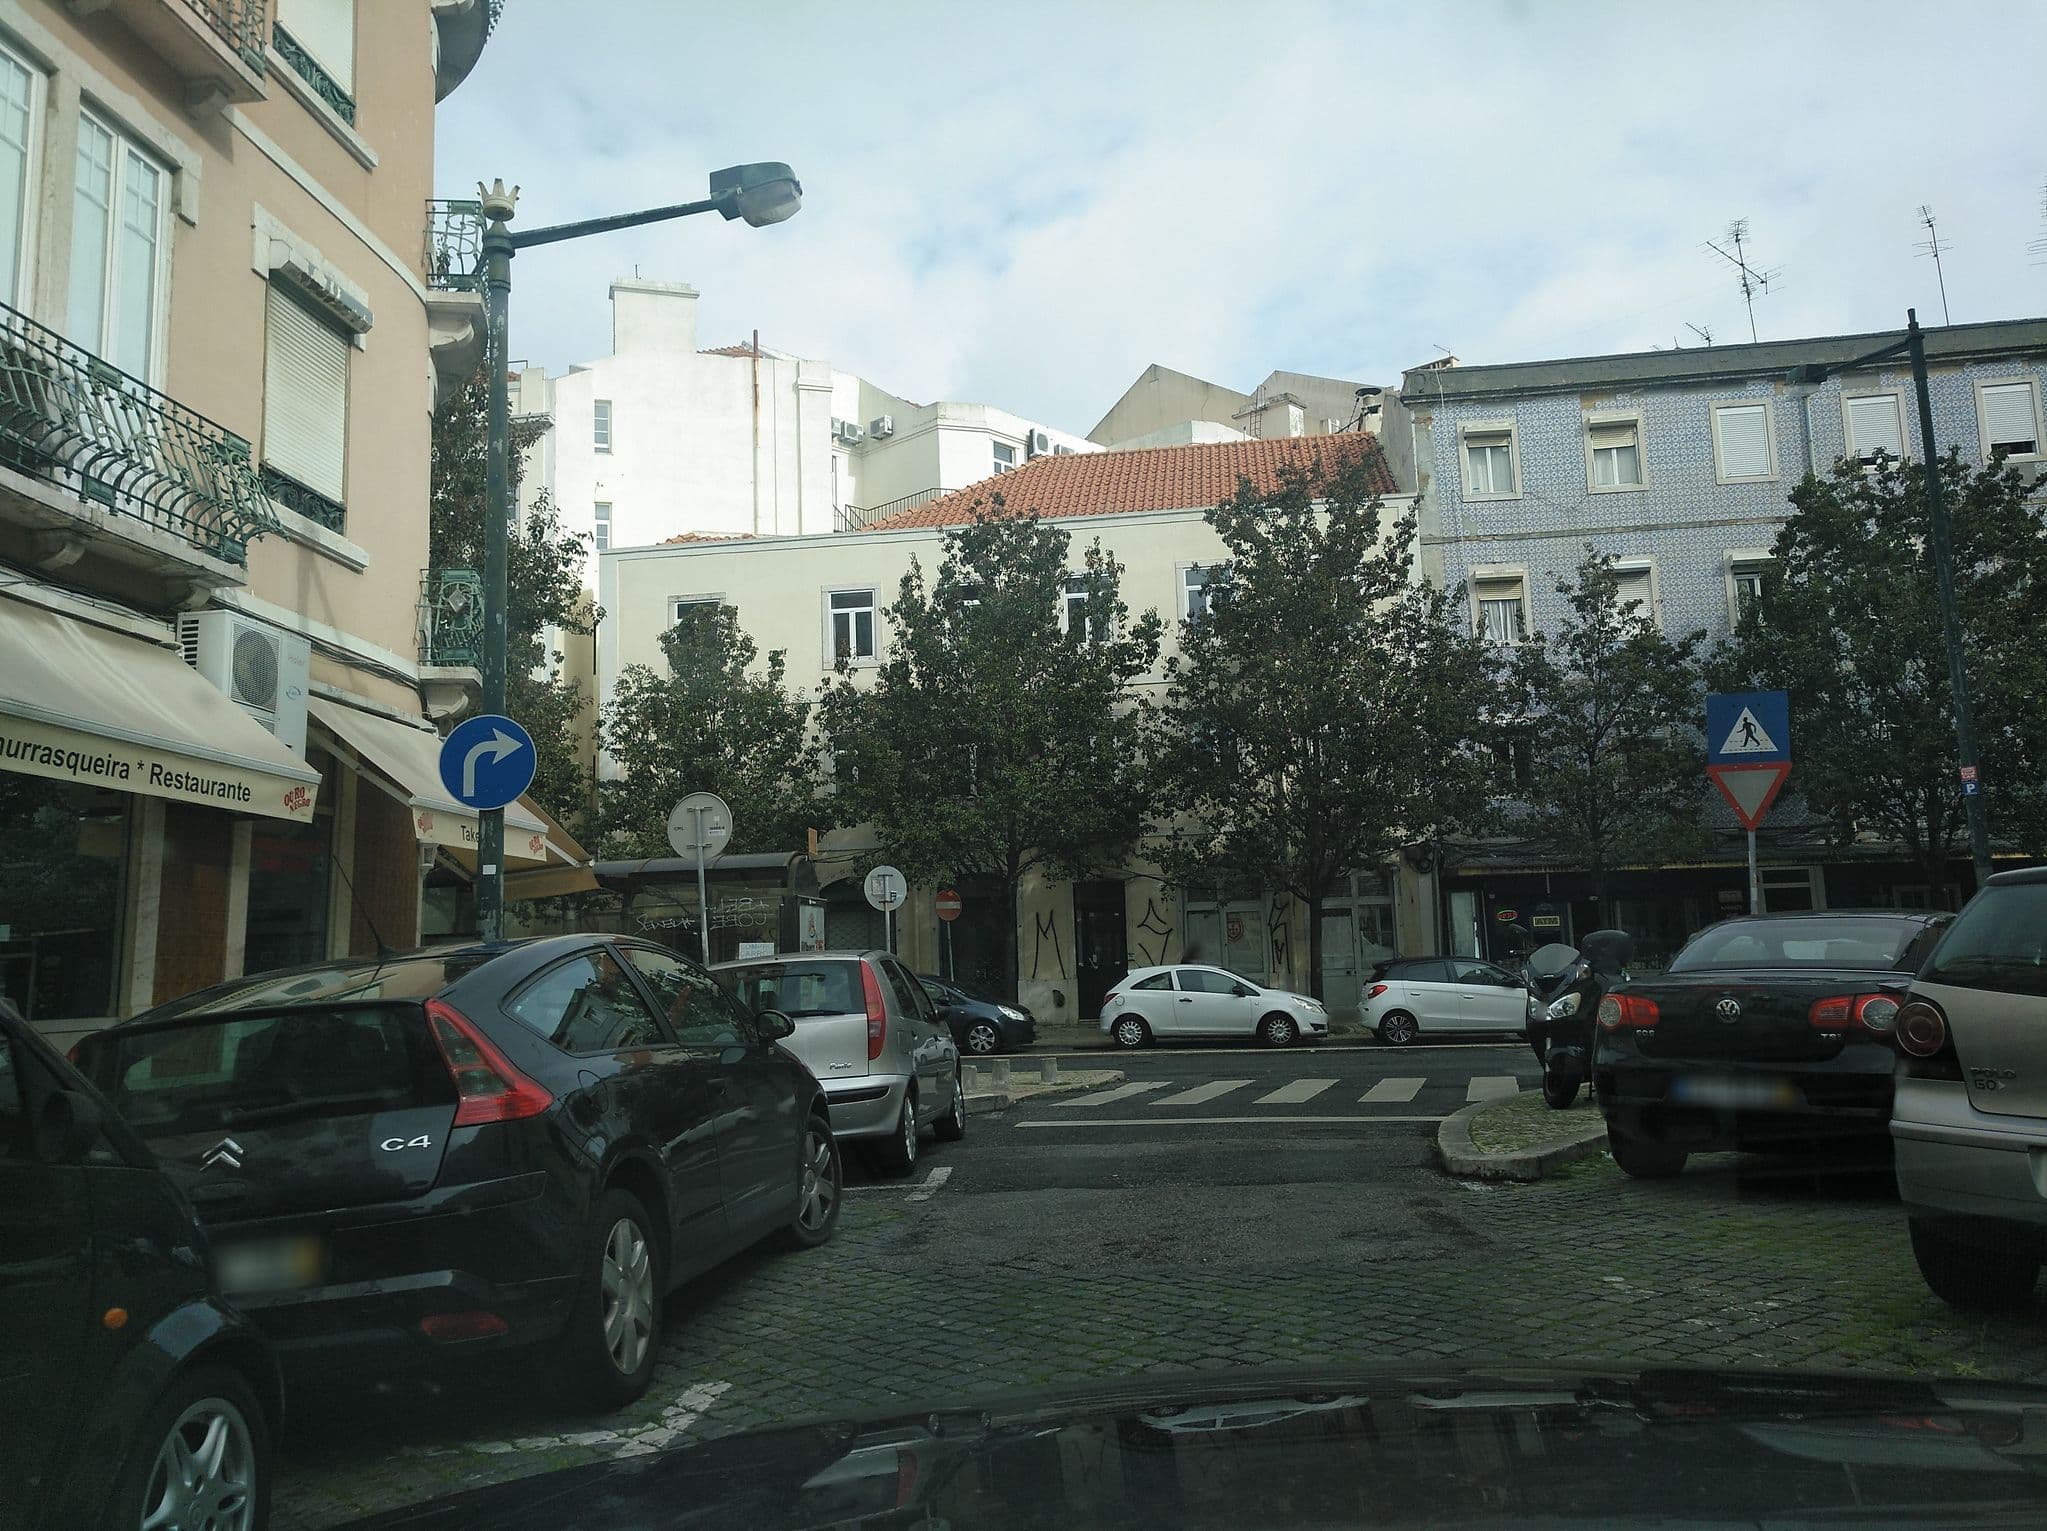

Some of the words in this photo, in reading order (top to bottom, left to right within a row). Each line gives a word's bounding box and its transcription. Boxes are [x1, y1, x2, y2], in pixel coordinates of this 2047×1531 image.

[149, 763, 251, 803] Restaurante
[284, 786, 305, 807] OURO
[829, 1062, 852, 1070] Punto
[380, 1134, 432, 1151] C4
